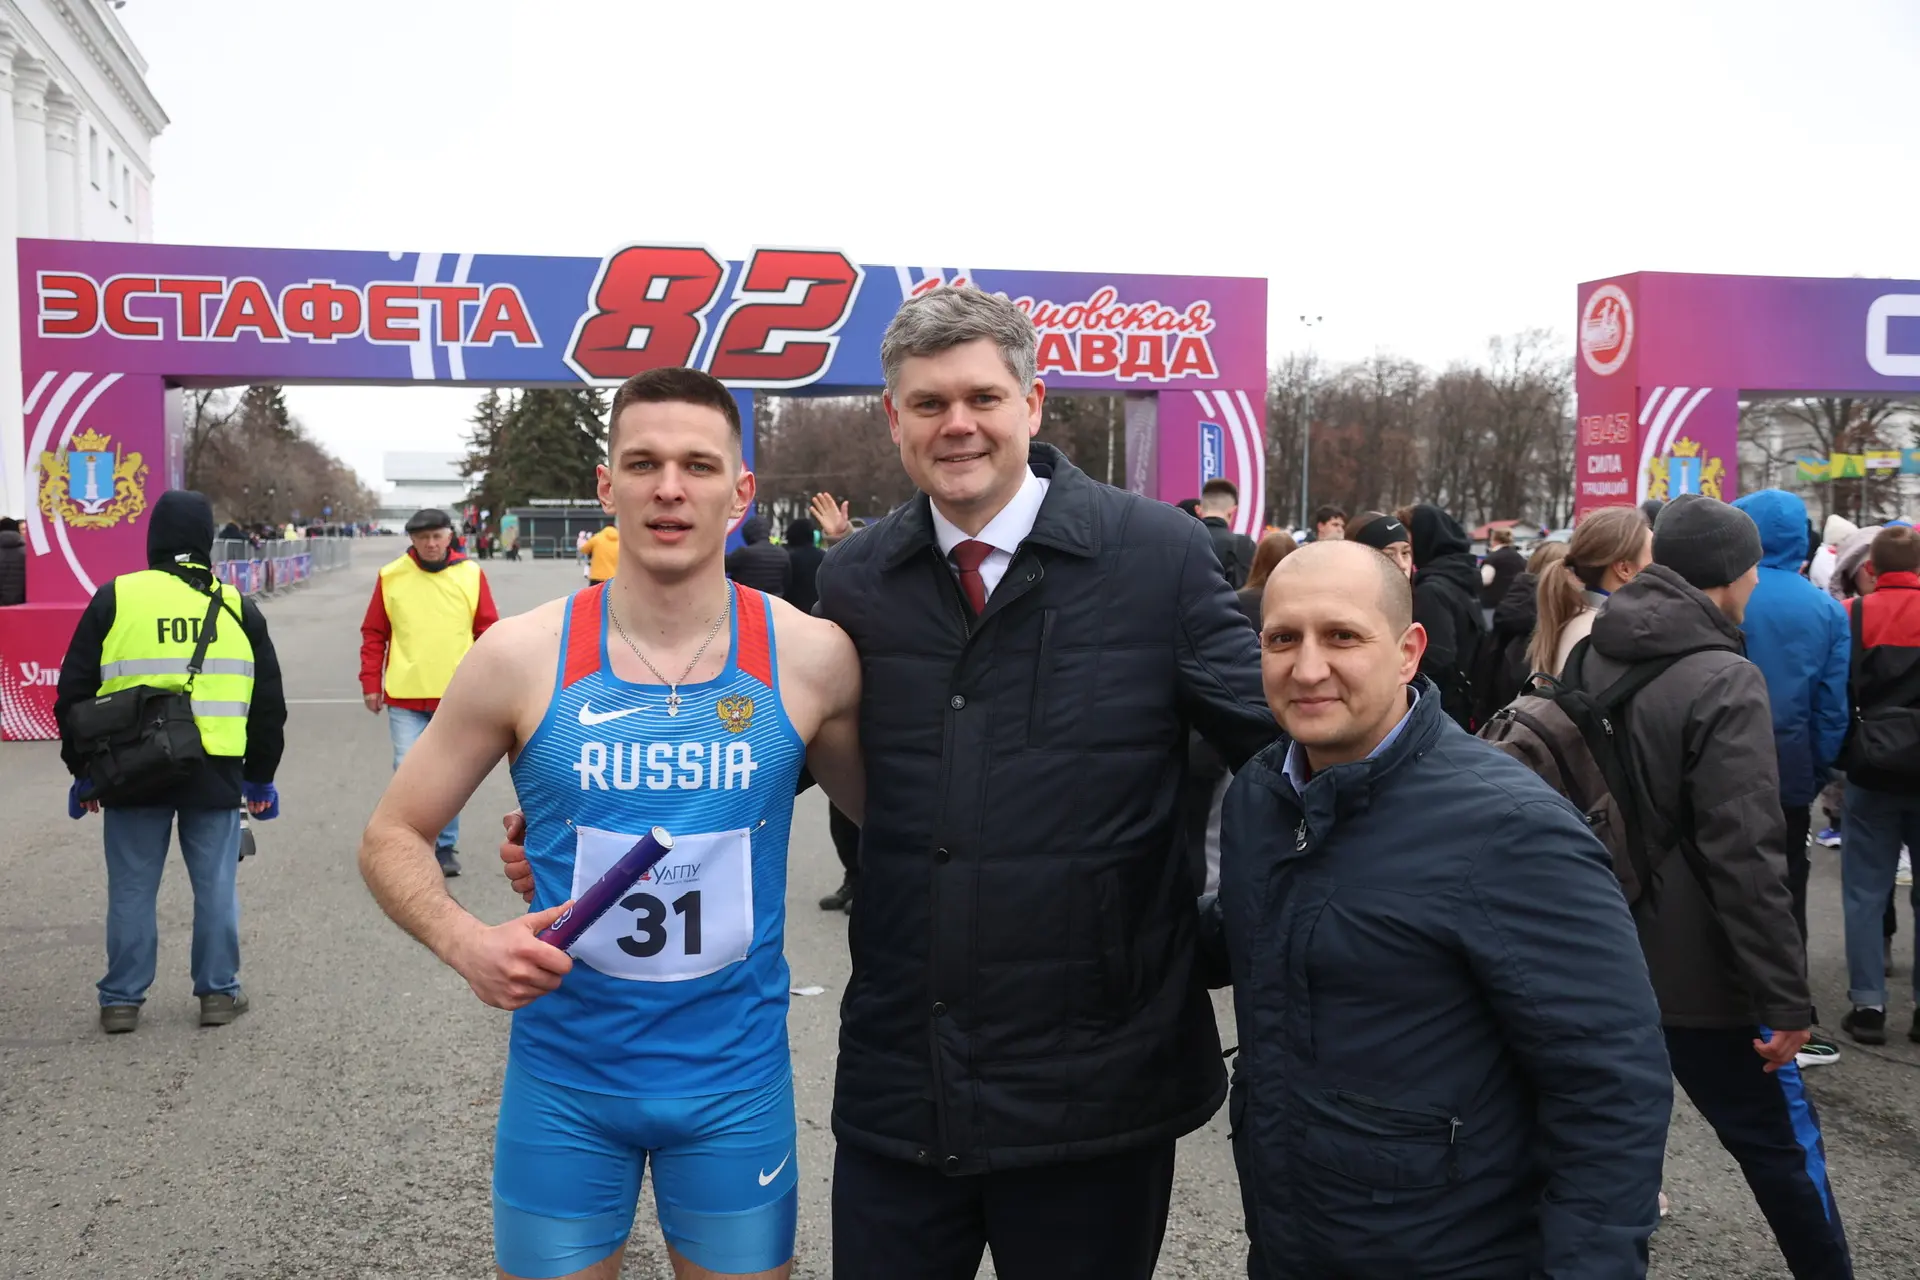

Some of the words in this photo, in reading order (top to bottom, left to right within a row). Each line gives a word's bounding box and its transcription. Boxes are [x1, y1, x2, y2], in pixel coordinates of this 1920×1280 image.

[37, 271, 543, 348] ЭСТАФЕТА
[565, 242, 865, 386] 82
[1037, 332, 1215, 378] АВДА
[1202, 427, 1215, 485] ПОРТ
[573, 742, 757, 790] RUSSIA
[617, 890, 701, 958] 31
